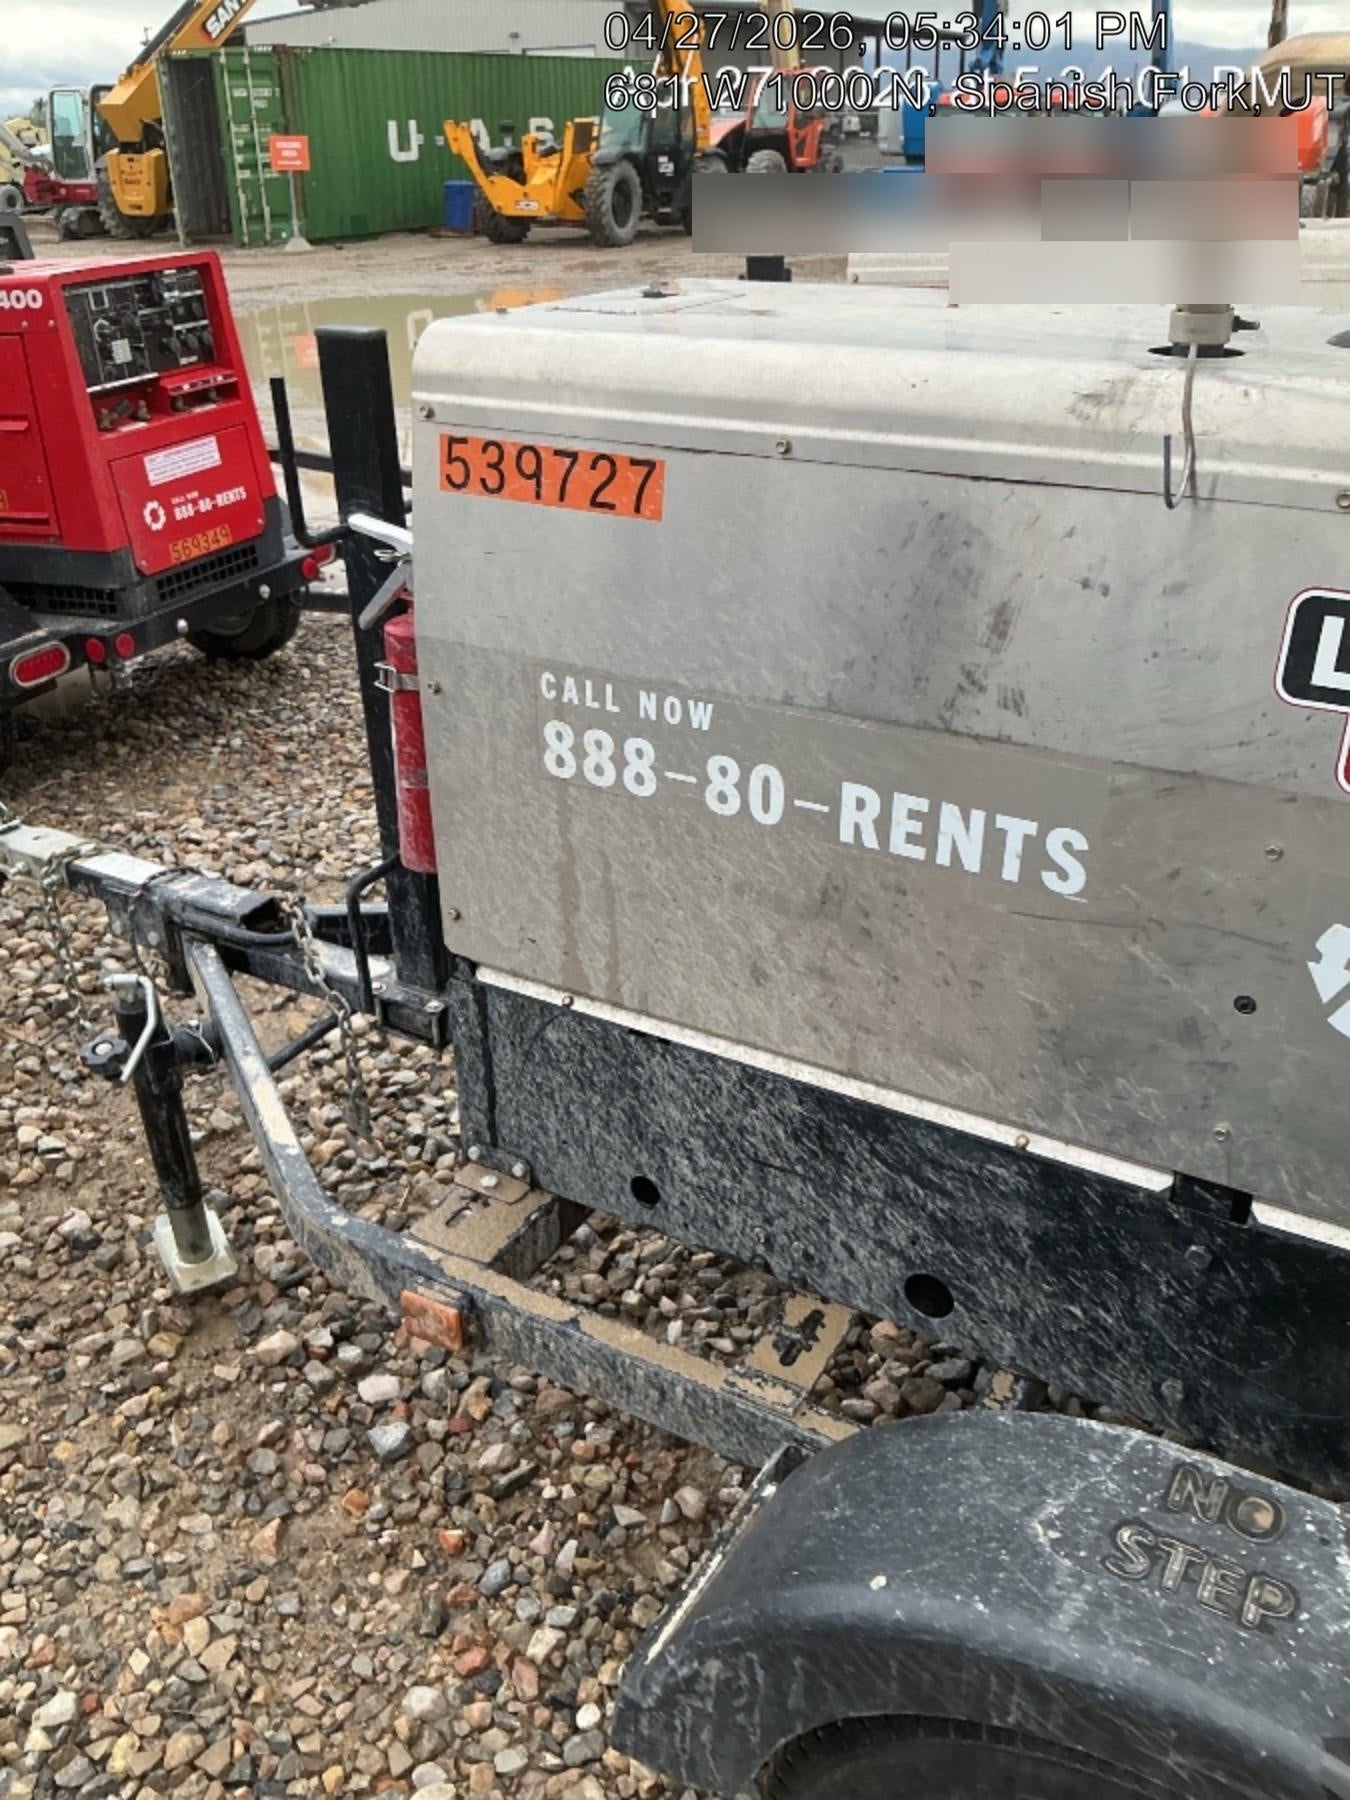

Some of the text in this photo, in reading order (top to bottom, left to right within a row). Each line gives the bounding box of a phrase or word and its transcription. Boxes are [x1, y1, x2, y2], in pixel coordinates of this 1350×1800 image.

[445, 436, 657, 515] 539727
[540, 671, 714, 732] CALL NOW
[543, 719, 1090, 897] 888-80-RENTS
[1165, 1462, 1287, 1544] NO
[1103, 1523, 1297, 1628] STEP
